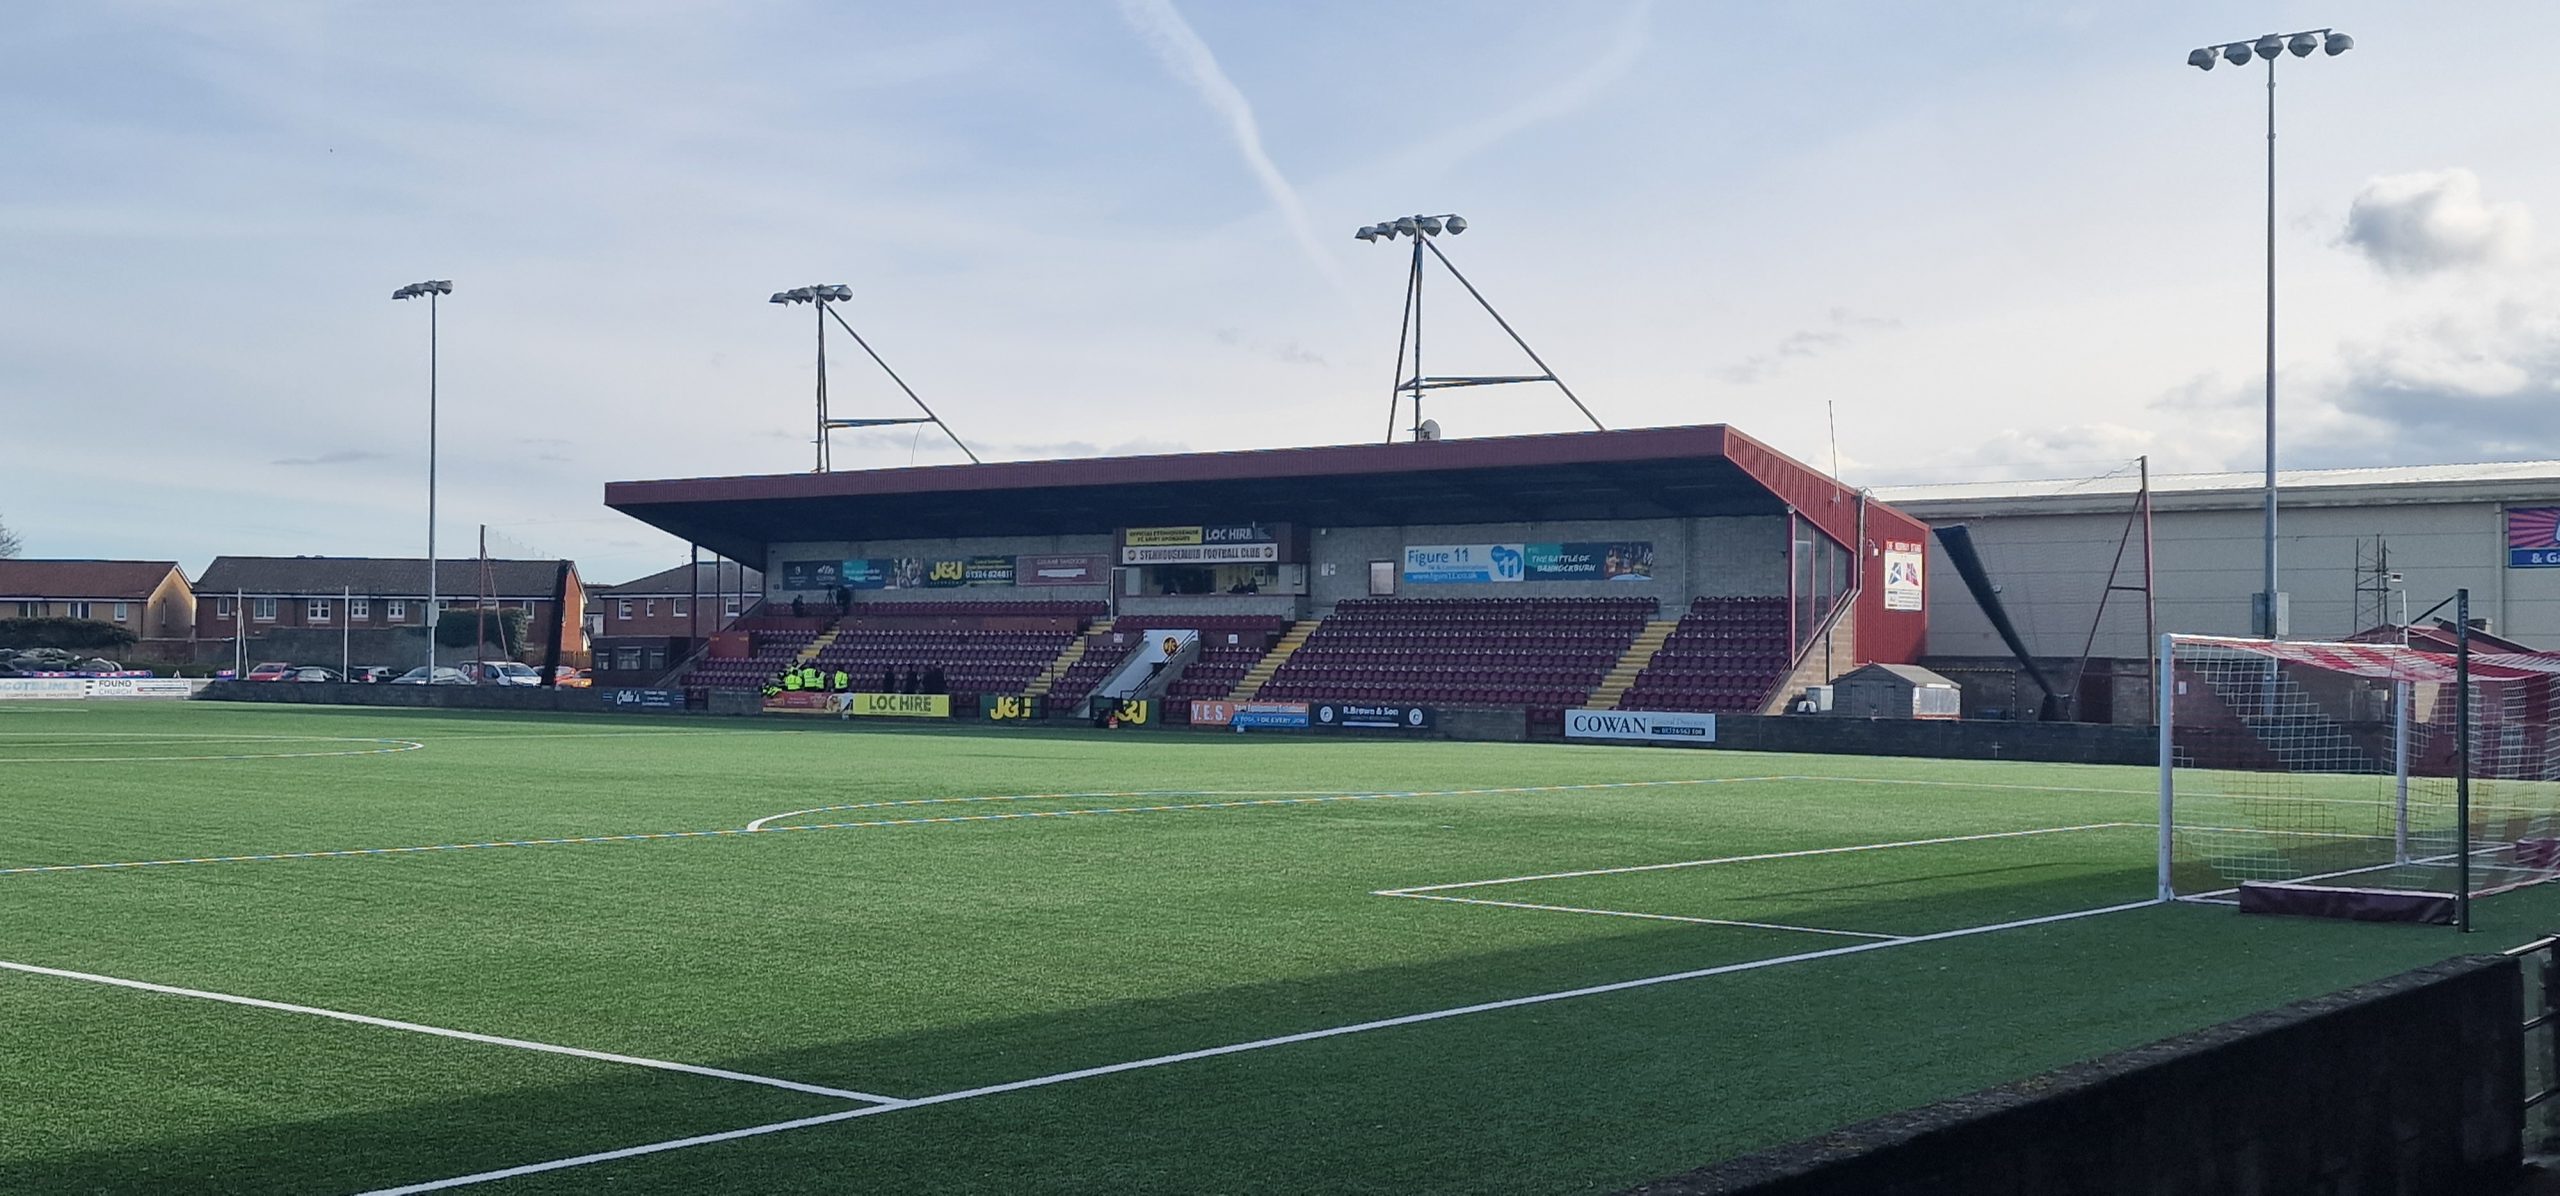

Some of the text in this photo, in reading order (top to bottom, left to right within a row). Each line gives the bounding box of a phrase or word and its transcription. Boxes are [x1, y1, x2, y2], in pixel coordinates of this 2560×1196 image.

[1205, 528, 1226, 540] LOC
[1203, 547, 1239, 559] FOOTBALL
[1241, 547, 1260, 558] CLUB
[1408, 547, 1468, 567] Figure 11
[1532, 554, 1591, 563] THE BATTLE OF
[2531, 552, 2560, 564] & G
[929, 561, 963, 581] J&J
[1500, 556, 1519, 578] 11
[1537, 564, 1596, 573] BANNOCKBURN
[98, 680, 132, 688] FOUND
[869, 695, 931, 712] LOC HIRE
[1191, 703, 1226, 721] Y.E.S.
[1376, 707, 1382, 715] &
[1383, 707, 1399, 716] Son
[1573, 715, 1647, 734] COWAN
